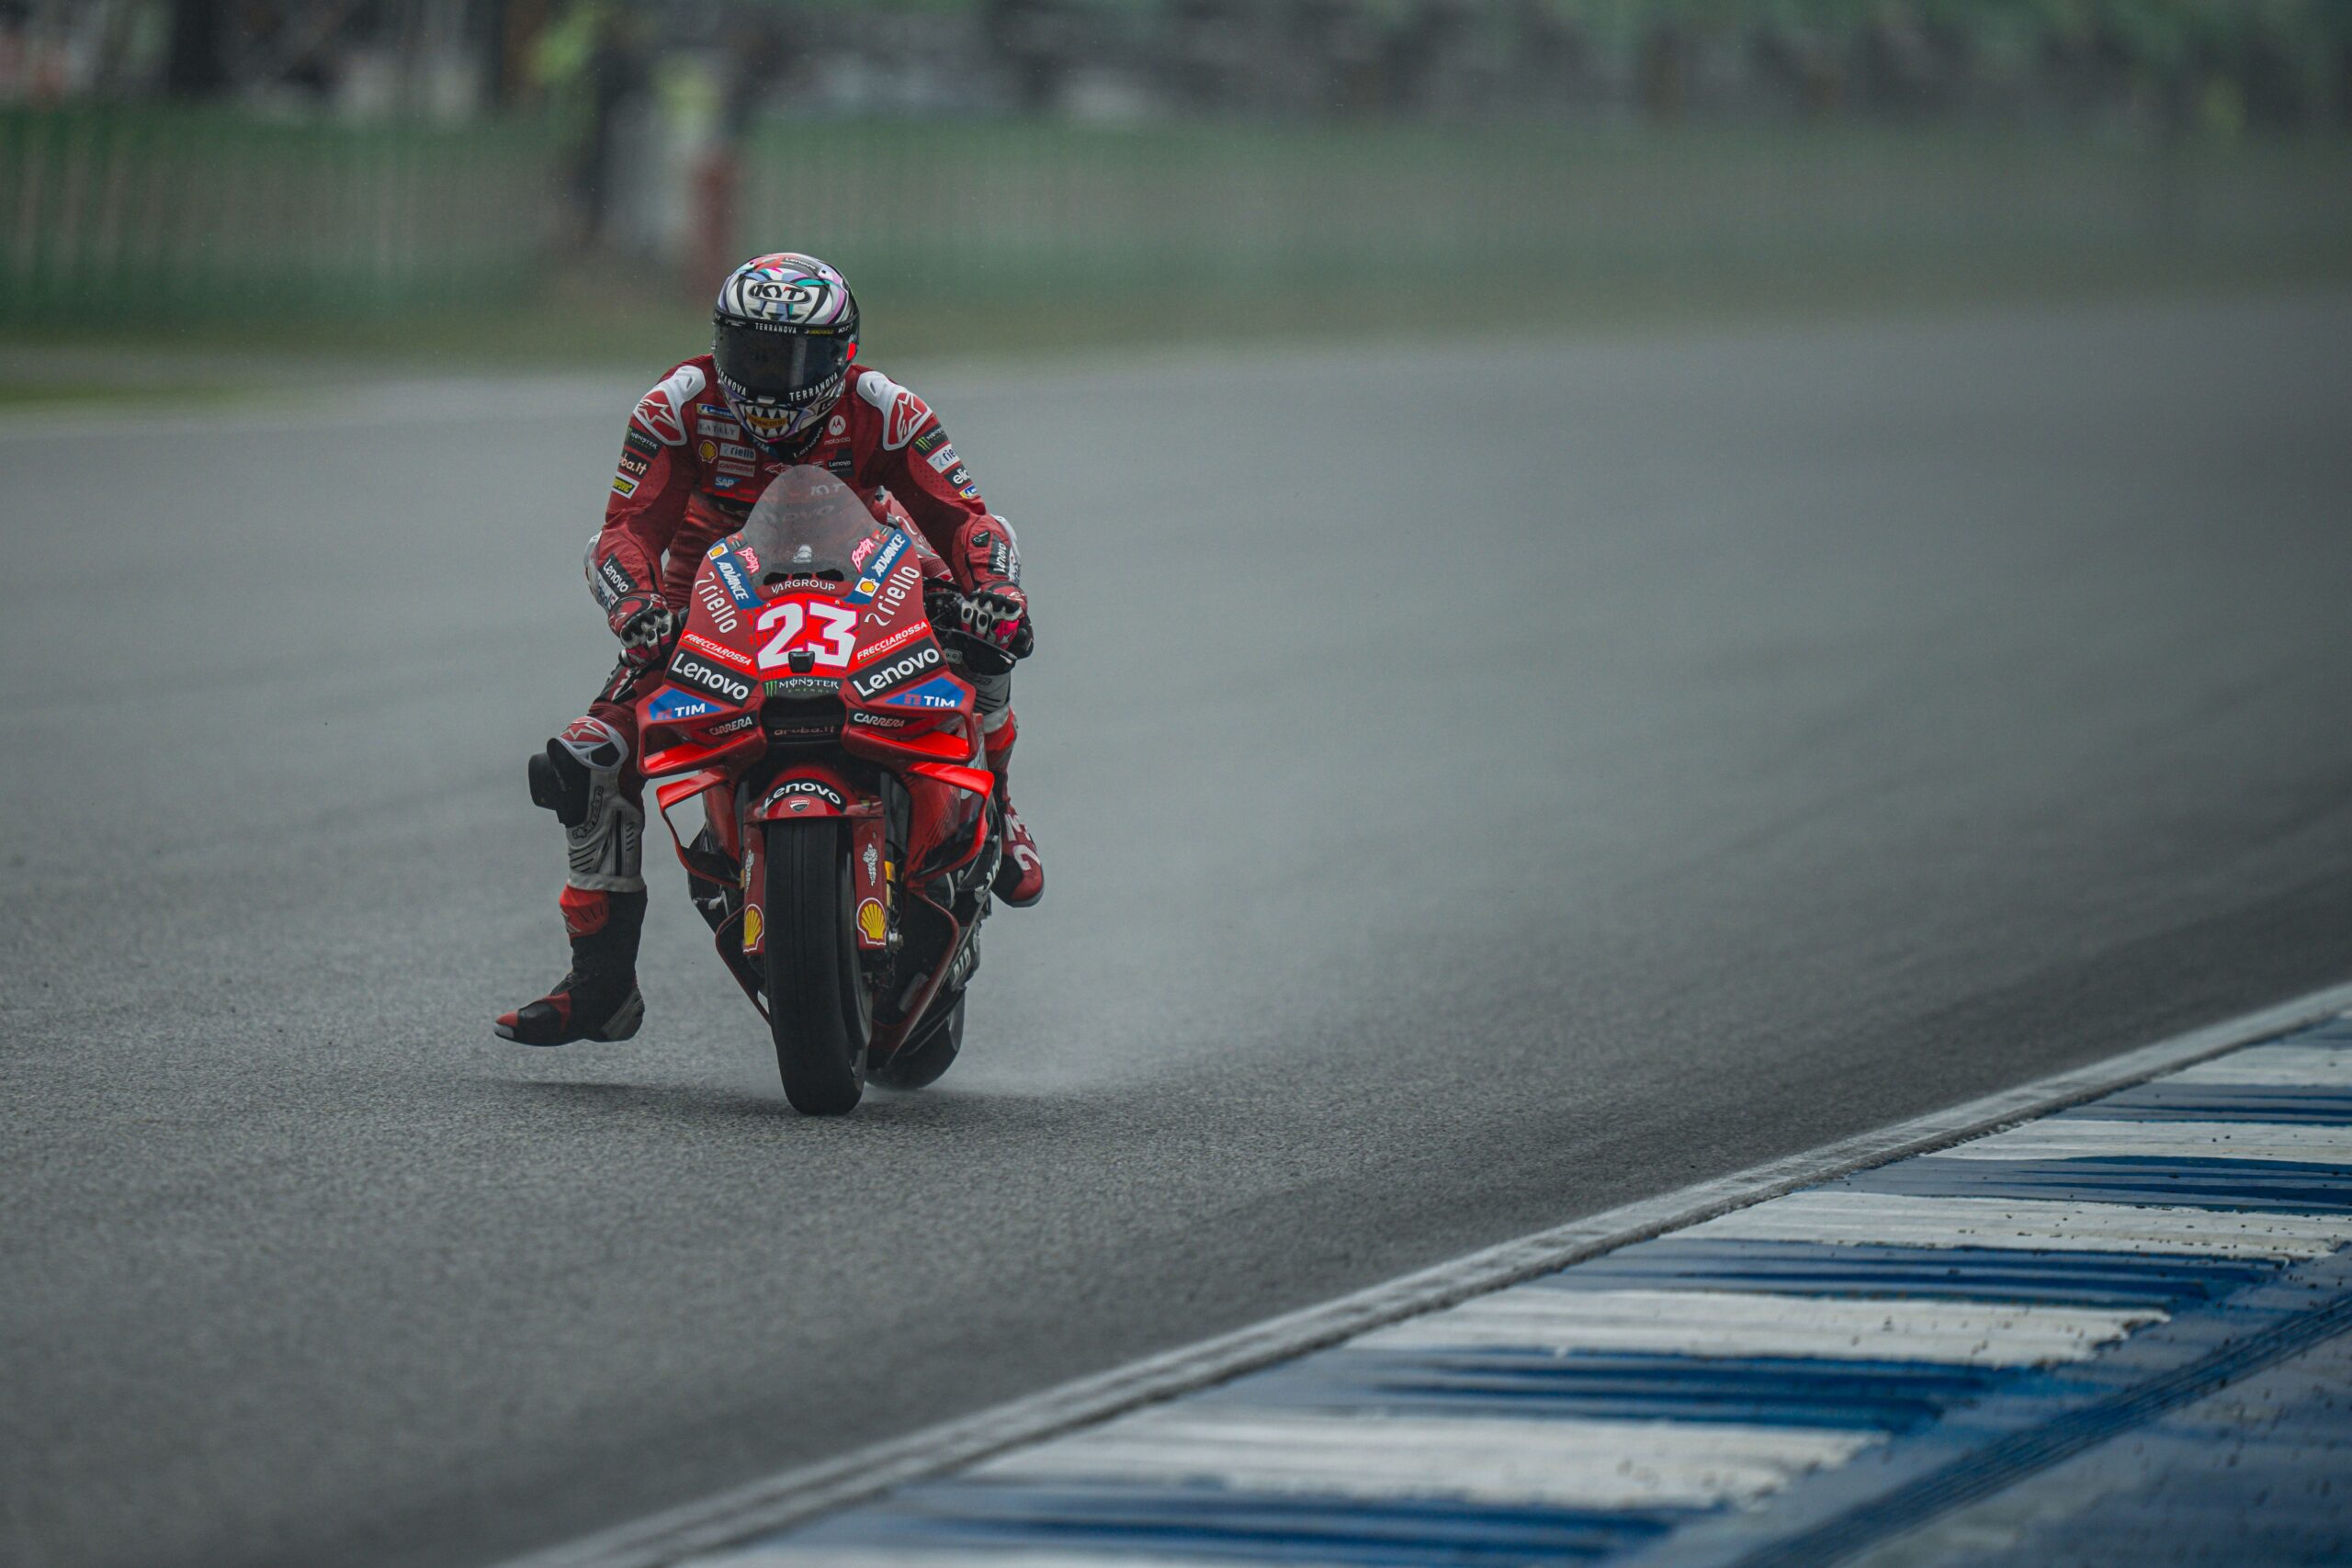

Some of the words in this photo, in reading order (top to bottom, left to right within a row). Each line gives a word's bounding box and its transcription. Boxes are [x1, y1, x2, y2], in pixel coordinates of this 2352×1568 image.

[785, 256, 816, 270] Lenovo
[750, 283, 806, 300] KYT
[754, 322, 797, 334] TERRANOVA
[789, 372, 838, 402] TERRANOVA
[729, 446, 755, 459] riello
[793, 426, 823, 458] Lenovo
[715, 478, 735, 488] SAP
[871, 533, 906, 578] ADVANCE
[603, 558, 629, 592] Lenovo
[717, 561, 750, 601] ADVANCE
[771, 579, 836, 595] VARGROUP
[877, 566, 921, 616] riello
[696, 584, 738, 634] riello
[756, 602, 857, 670] 23
[856, 621, 928, 660] FRECCIAROSSA
[684, 634, 753, 666] FRECCIAROSSA
[671, 653, 749, 700] Lenovo
[778, 678, 840, 690] MONSTER
[853, 648, 940, 697] Lenovo
[674, 703, 706, 717] TIM
[923, 695, 956, 707] TIM
[709, 716, 752, 736] CARRERA
[854, 713, 905, 728] CARRERA
[763, 783, 841, 808] Lenovo
